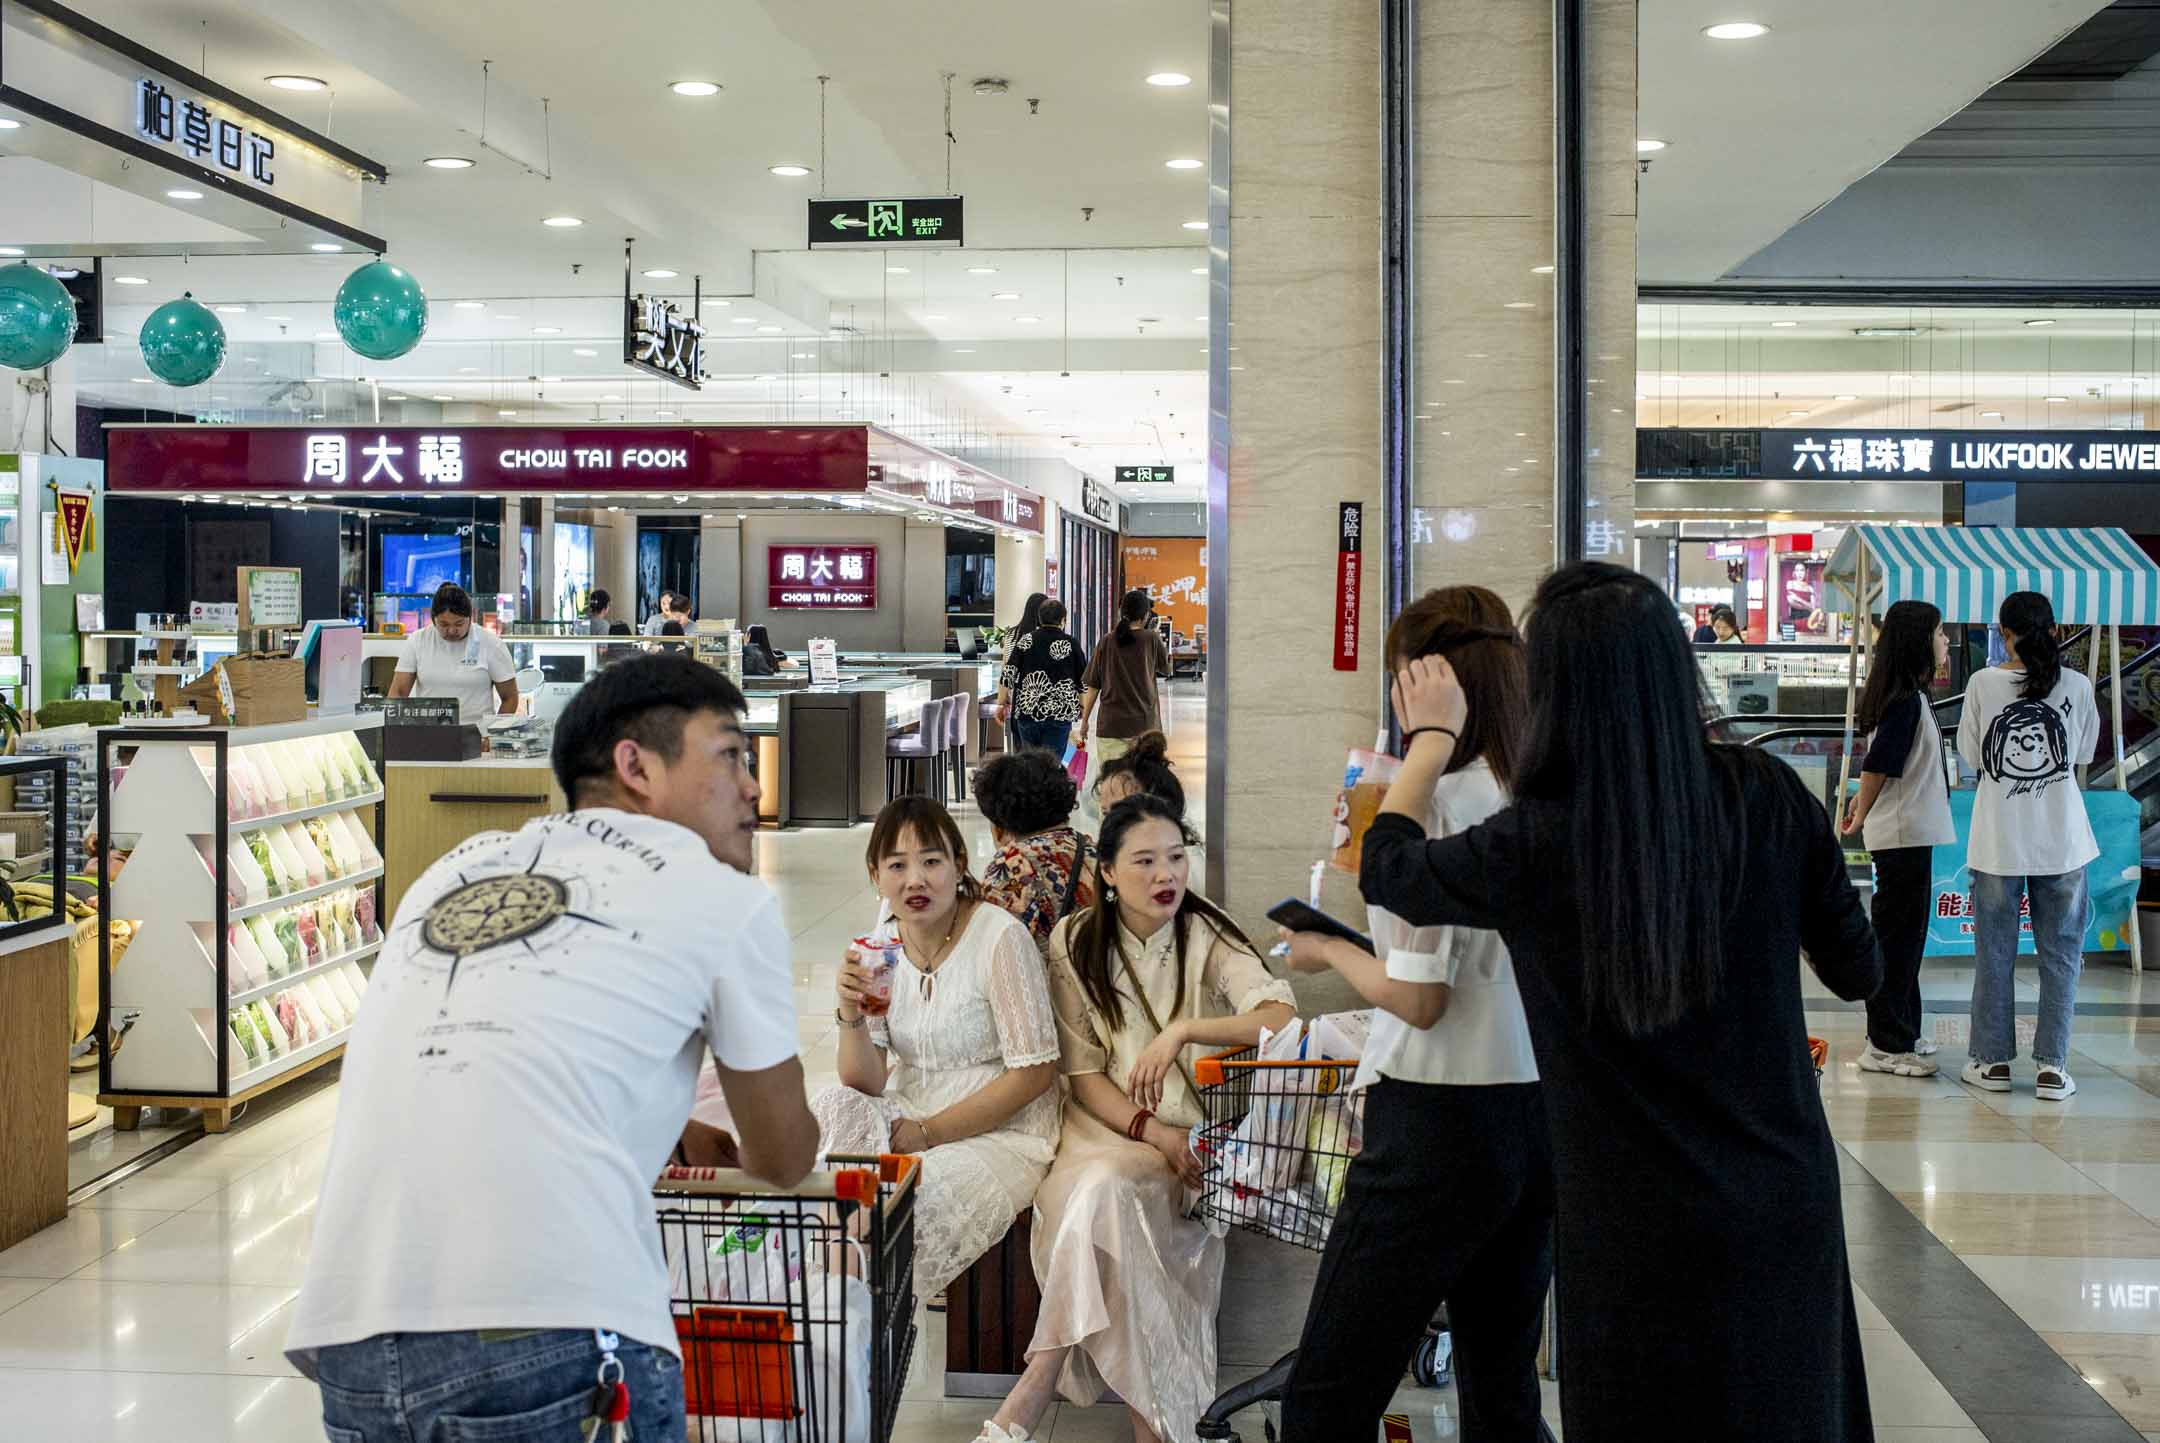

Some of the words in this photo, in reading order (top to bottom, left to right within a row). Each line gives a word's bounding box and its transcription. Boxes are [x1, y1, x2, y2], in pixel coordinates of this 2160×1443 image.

[911, 217, 943, 227] 安全出口
[915, 227, 938, 235] EXIT
[303, 434, 464, 484] 周大福
[499, 449, 567, 469] CHOW
[573, 449, 612, 468] TAI
[622, 449, 688, 468] FOOK
[1792, 437, 1934, 474] 六福珠寶
[1951, 443, 2074, 470] LUKFOOK
[781, 554, 863, 580] 周大福
[781, 593, 812, 602] CHOW
[813, 593, 831, 602] TAI
[834, 593, 862, 602] FOOK
